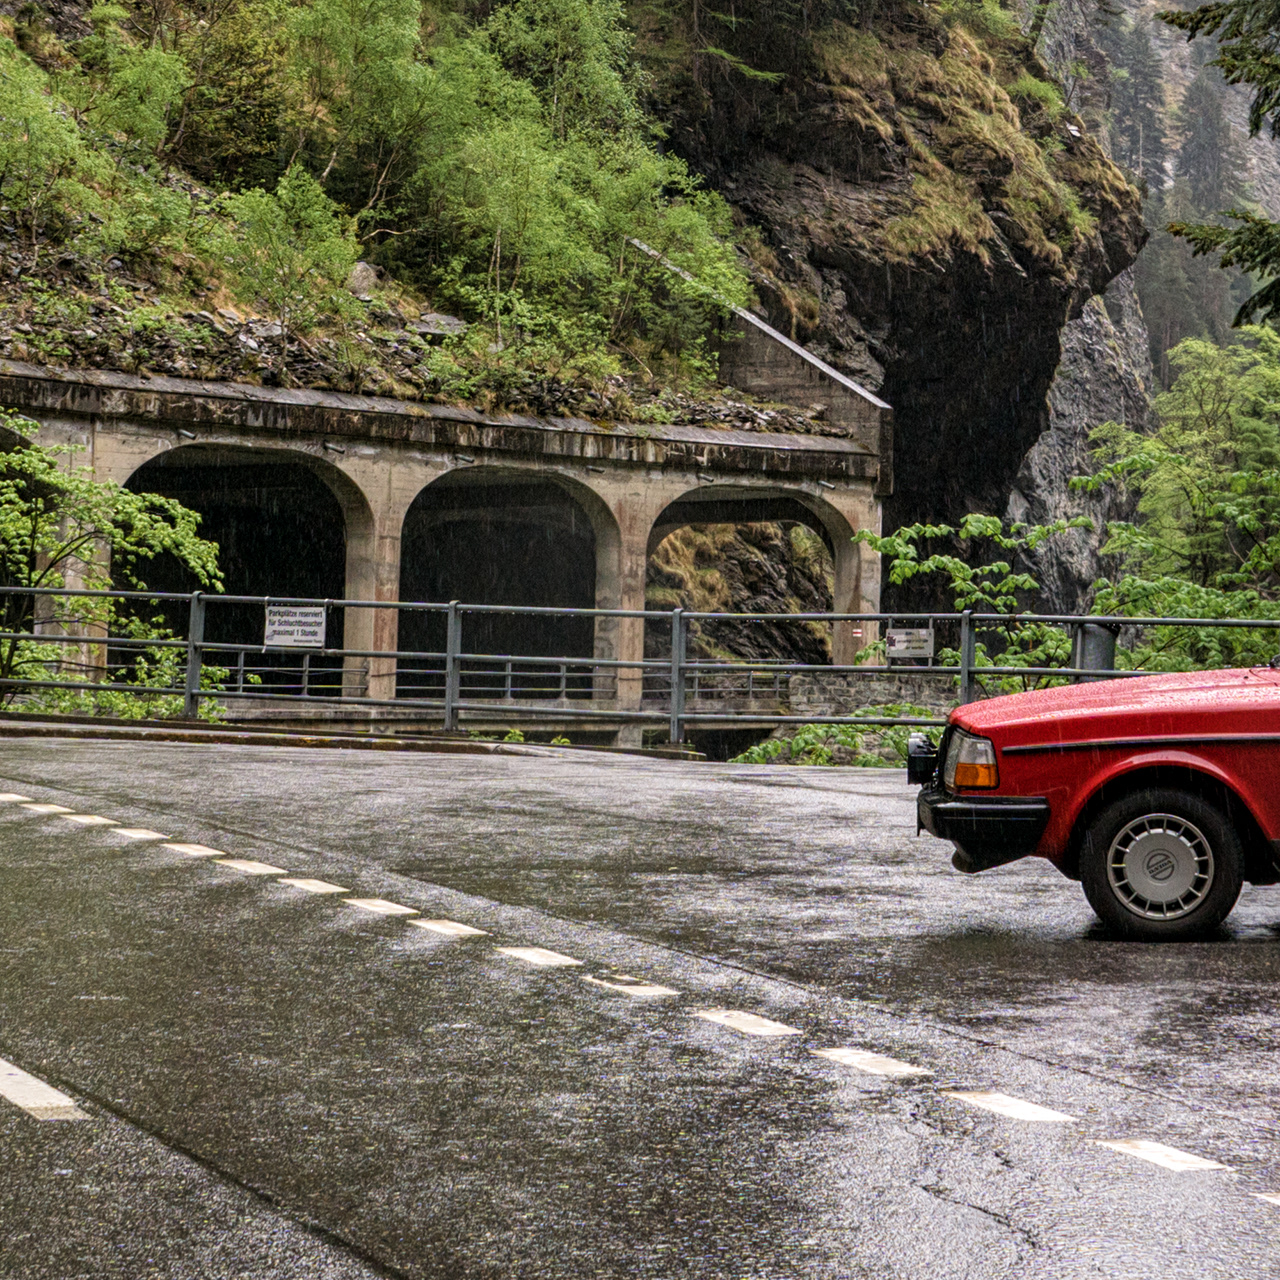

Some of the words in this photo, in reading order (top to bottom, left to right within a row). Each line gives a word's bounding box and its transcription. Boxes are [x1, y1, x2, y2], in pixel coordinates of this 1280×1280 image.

[268, 609, 297, 618] Parkplätze
[299, 610, 322, 618] reserviert
[300, 629, 318, 637] Stunde
